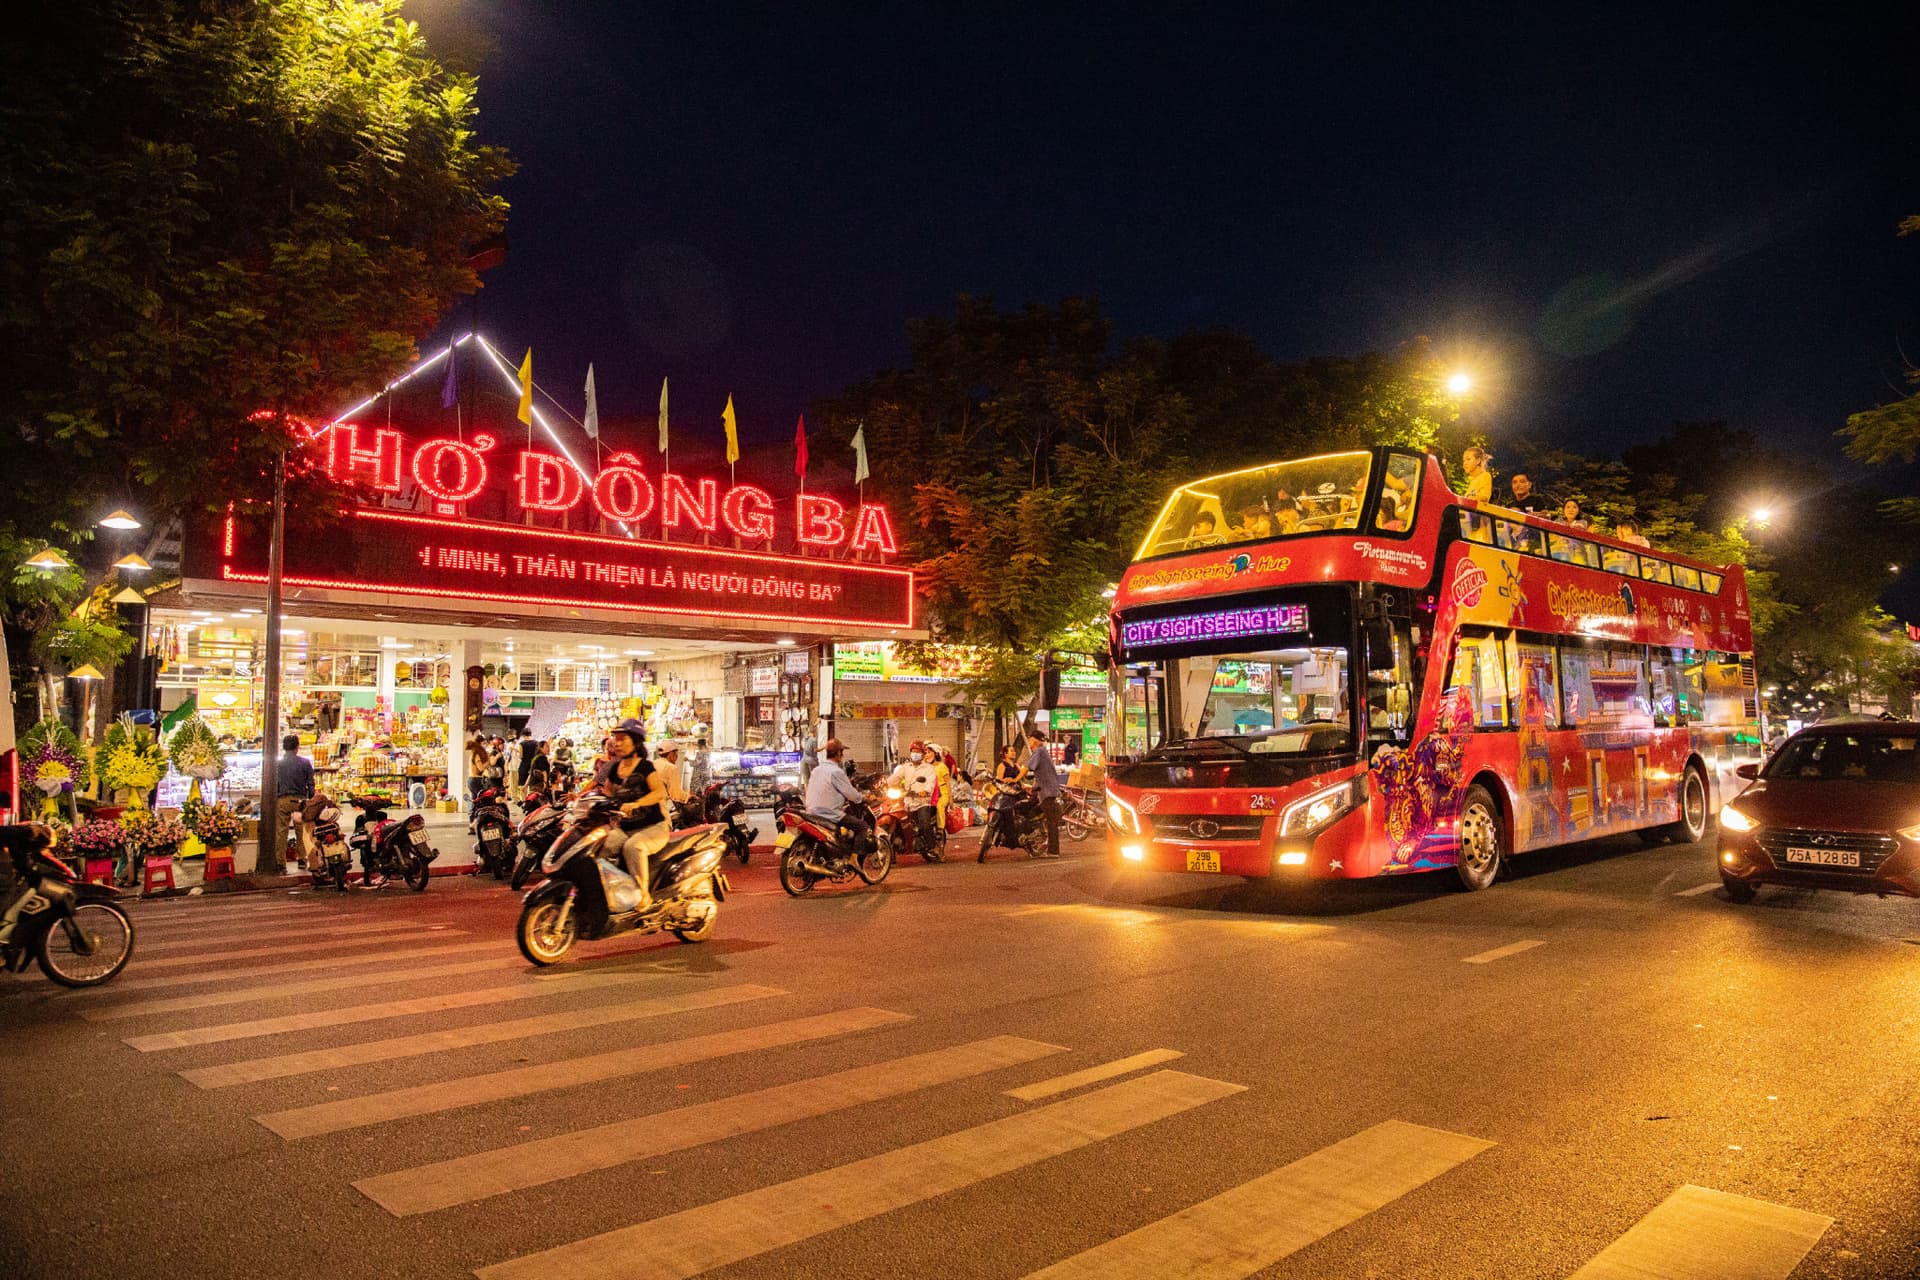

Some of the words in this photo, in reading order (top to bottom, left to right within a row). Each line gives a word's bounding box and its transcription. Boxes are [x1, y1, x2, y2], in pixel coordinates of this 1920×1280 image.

[248, 410, 496, 516] HỢ
[797, 493, 898, 554] BA
[438, 548, 507, 577] MINH,
[512, 554, 576, 579] THÂN
[1256, 556, 1292, 573] Hue
[1455, 570, 1487, 600] OFFICIAL
[1128, 624, 1157, 642] CITY
[1160, 612, 1263, 638] SIGHTSEEING
[1267, 607, 1303, 628] HUE
[1195, 851, 1211, 861] 29B
